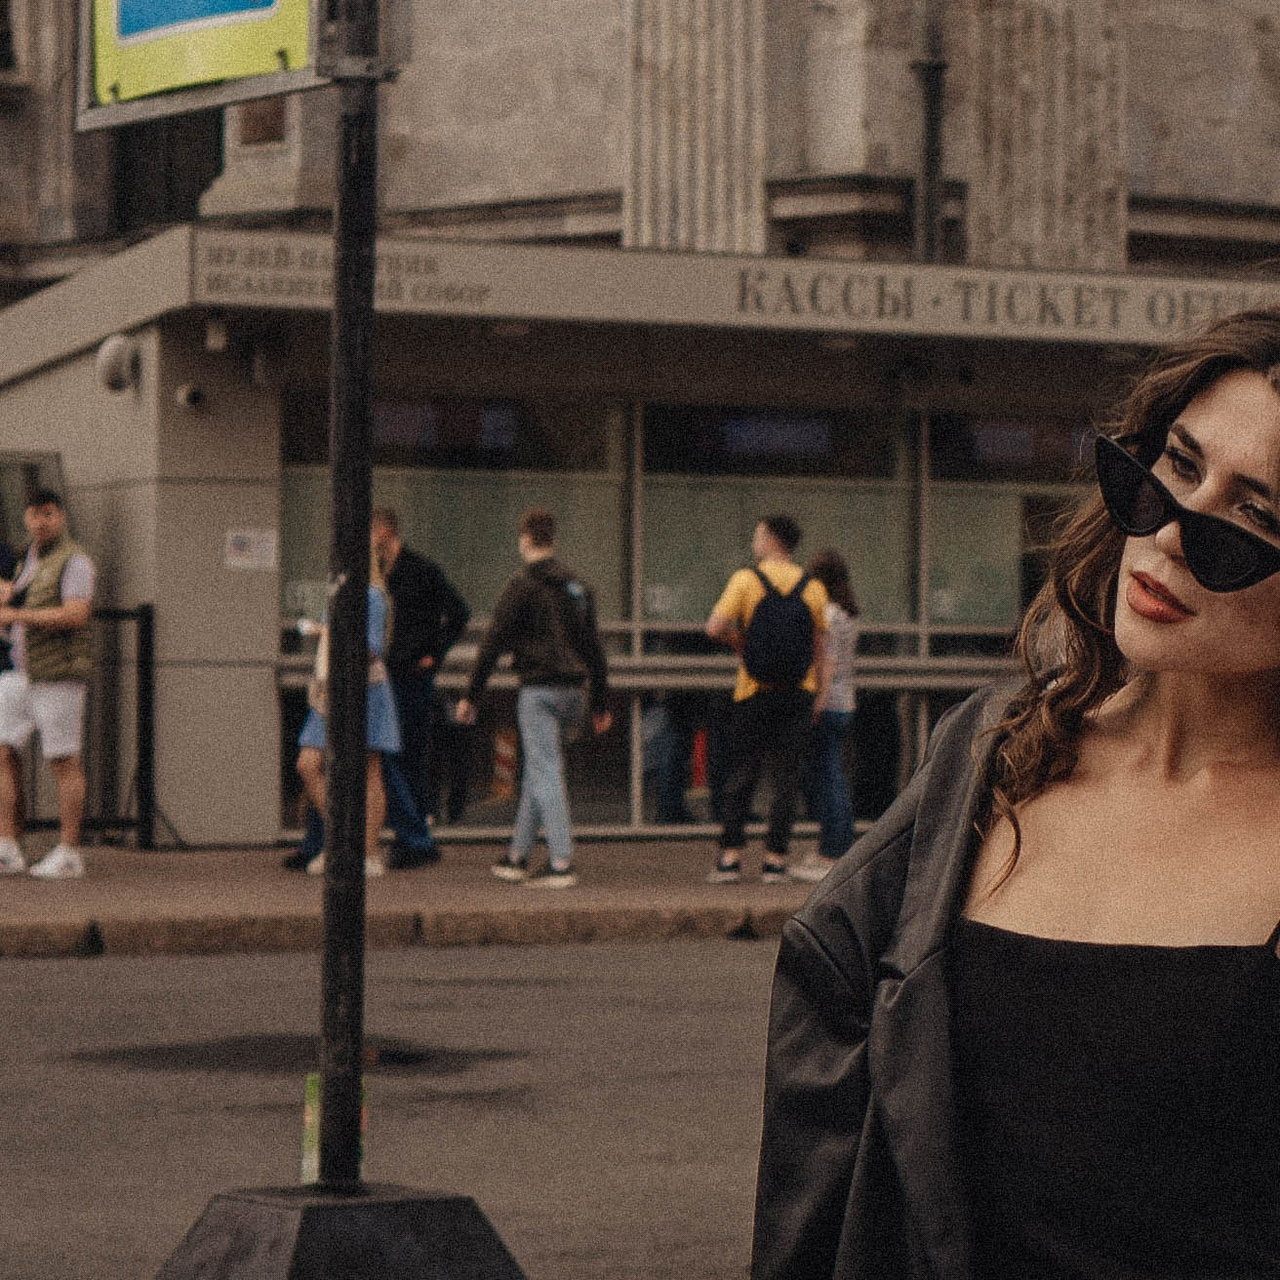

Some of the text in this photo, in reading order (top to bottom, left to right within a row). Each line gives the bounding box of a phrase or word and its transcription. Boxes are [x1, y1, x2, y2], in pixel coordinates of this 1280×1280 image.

[735, 267, 1247, 329] КАССЫ TICKET OFF
